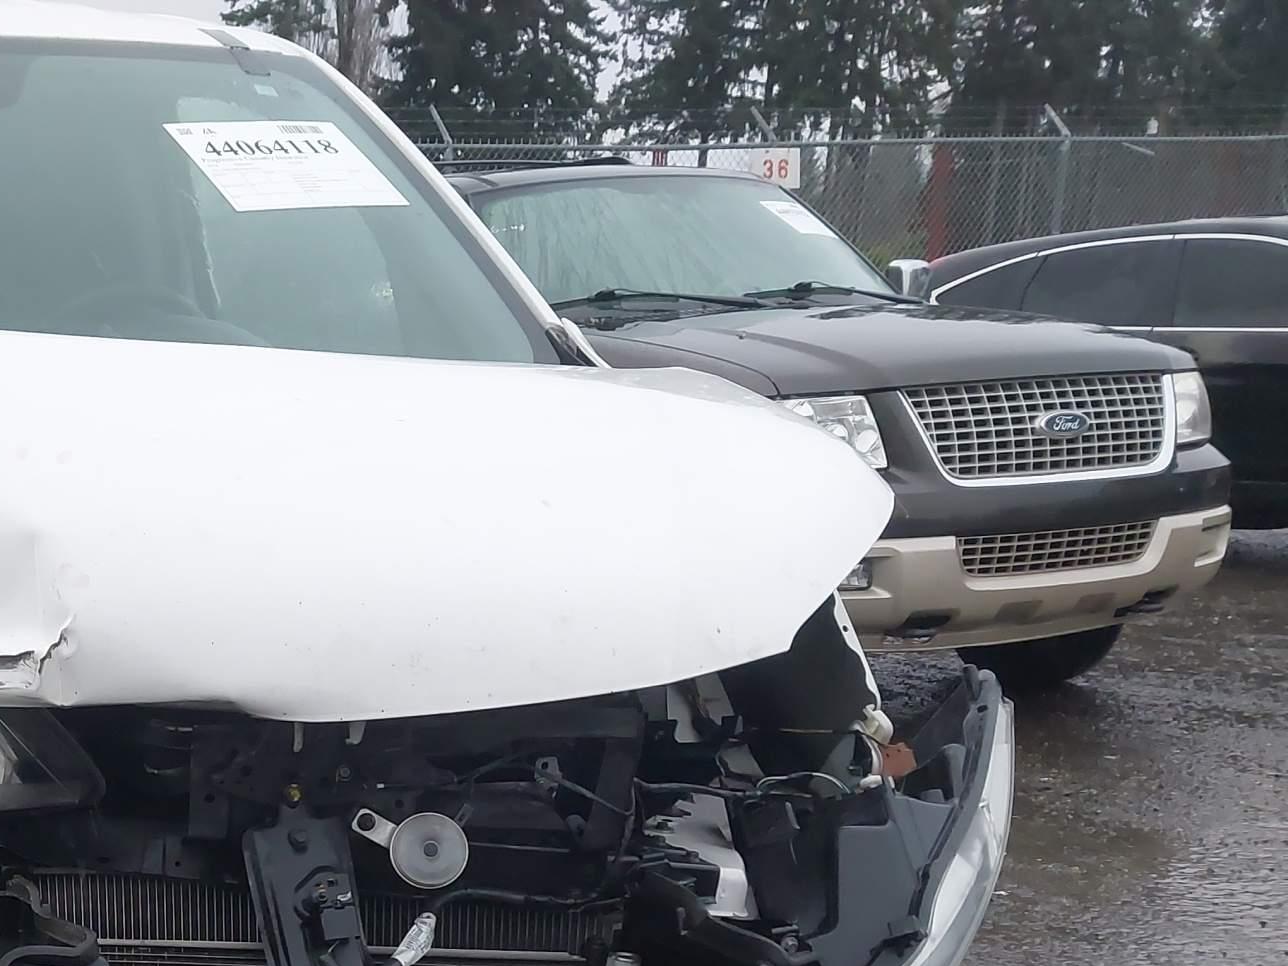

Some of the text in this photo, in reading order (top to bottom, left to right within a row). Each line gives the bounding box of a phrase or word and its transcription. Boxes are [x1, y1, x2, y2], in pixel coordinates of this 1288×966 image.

[204, 138, 340, 157] 44064118
[763, 159, 789, 179] 36
[1053, 416, 1080, 430] Ford
